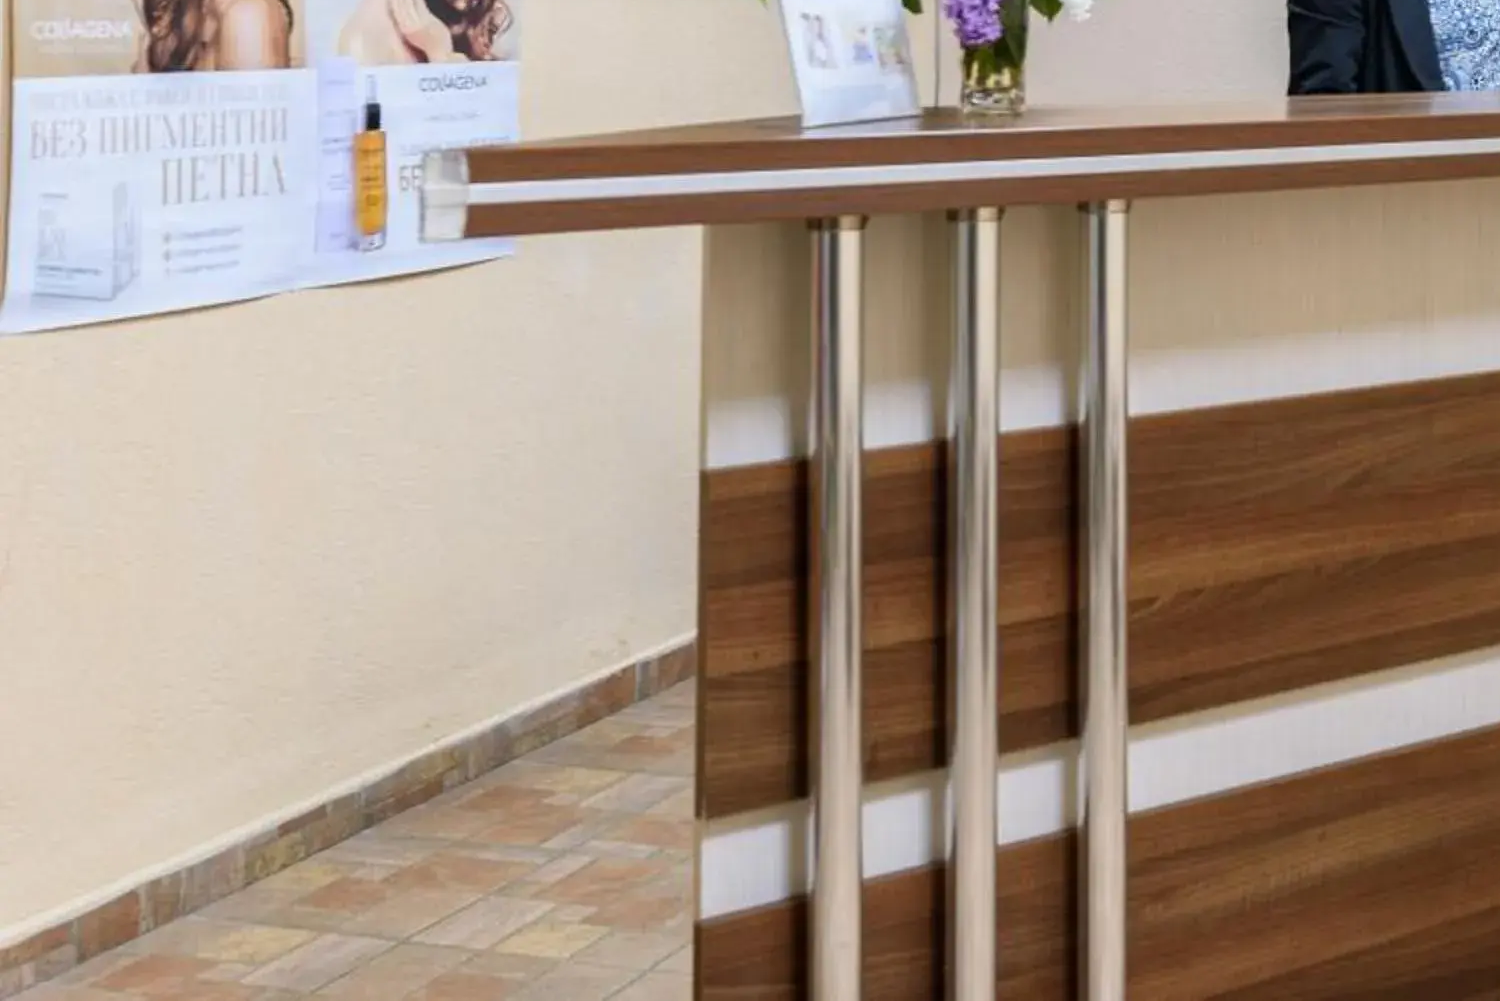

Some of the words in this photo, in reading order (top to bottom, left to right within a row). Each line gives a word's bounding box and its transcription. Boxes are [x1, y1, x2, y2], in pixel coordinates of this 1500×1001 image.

[30, 117, 88, 160] БЕЗ
[160, 150, 290, 207] ПЕТНА
[399, 164, 424, 191] БЕ
